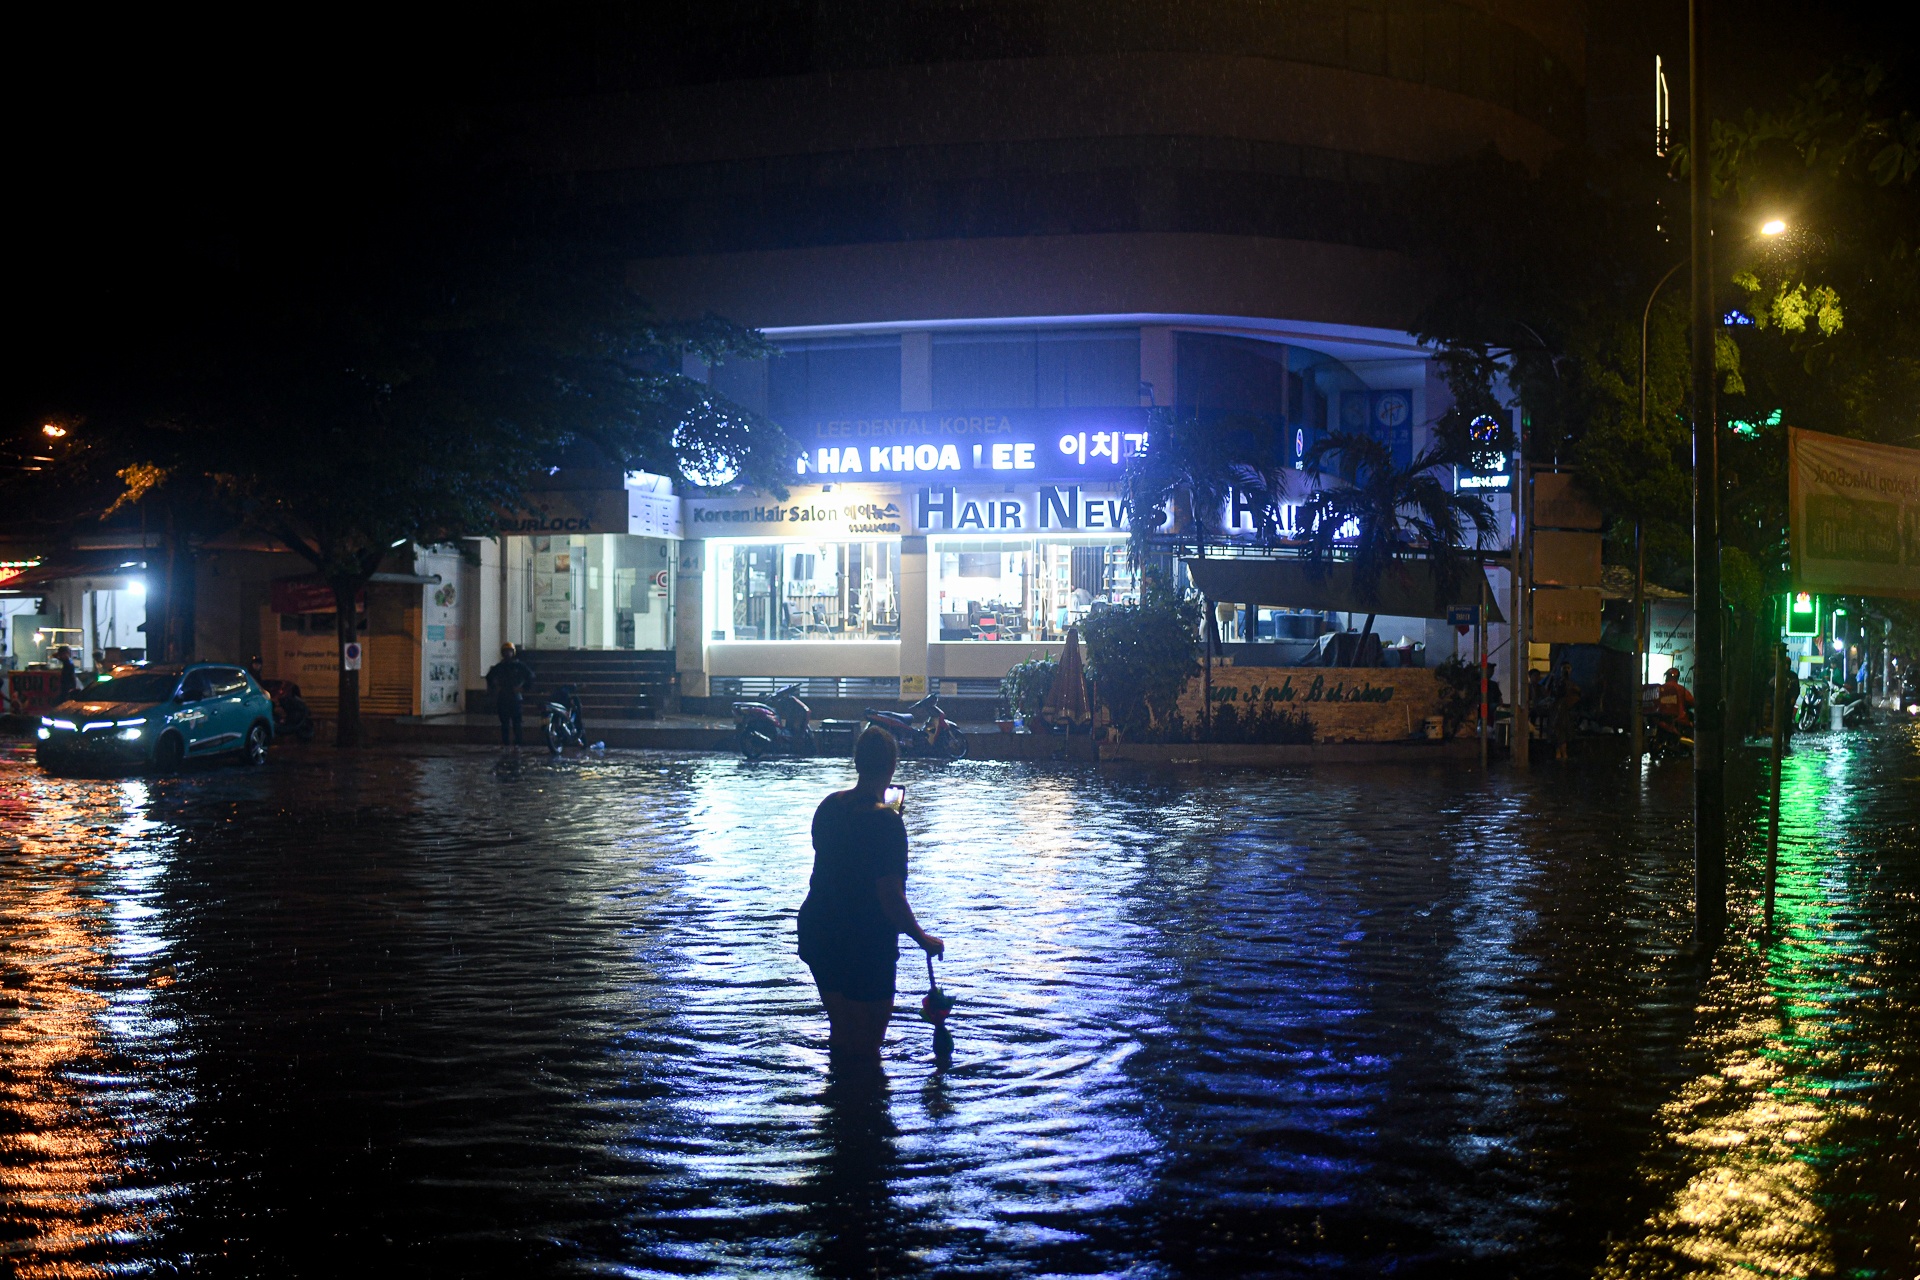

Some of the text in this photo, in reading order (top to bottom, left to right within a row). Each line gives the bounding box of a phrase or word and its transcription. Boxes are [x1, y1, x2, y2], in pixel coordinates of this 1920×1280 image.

[816, 416, 1011, 438] LEE DENTAL KOREA
[870, 444, 961, 472] KHOA
[973, 443, 1036, 471] LEE
[694, 506, 750, 523] Korean
[754, 505, 787, 522] Hair
[788, 506, 837, 522] Salon
[918, 486, 1021, 529] HAIR
